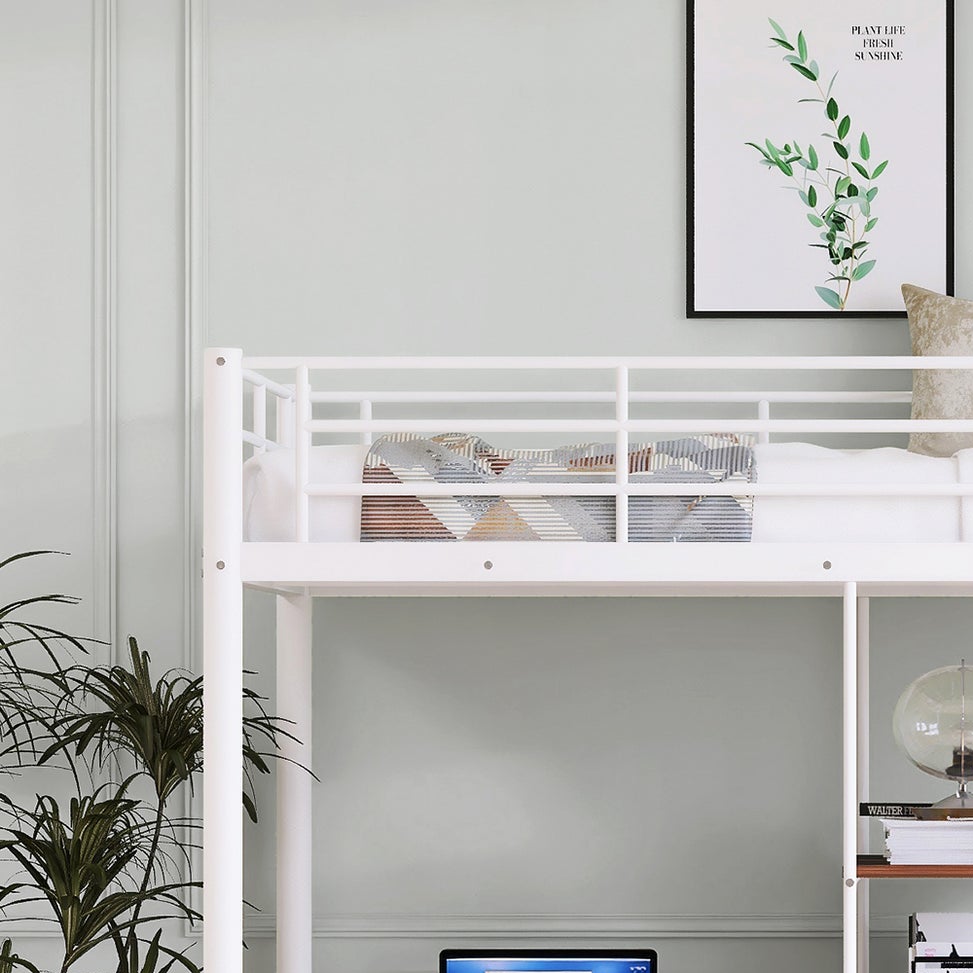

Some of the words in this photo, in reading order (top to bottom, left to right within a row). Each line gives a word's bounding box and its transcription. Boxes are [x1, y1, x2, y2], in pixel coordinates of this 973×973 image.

[851, 25, 881, 35] PLANT
[884, 25, 906, 35] LIFE
[863, 38, 894, 48] FRESH
[854, 51, 903, 61] SUNSHINE
[867, 805, 903, 816] WALTER
